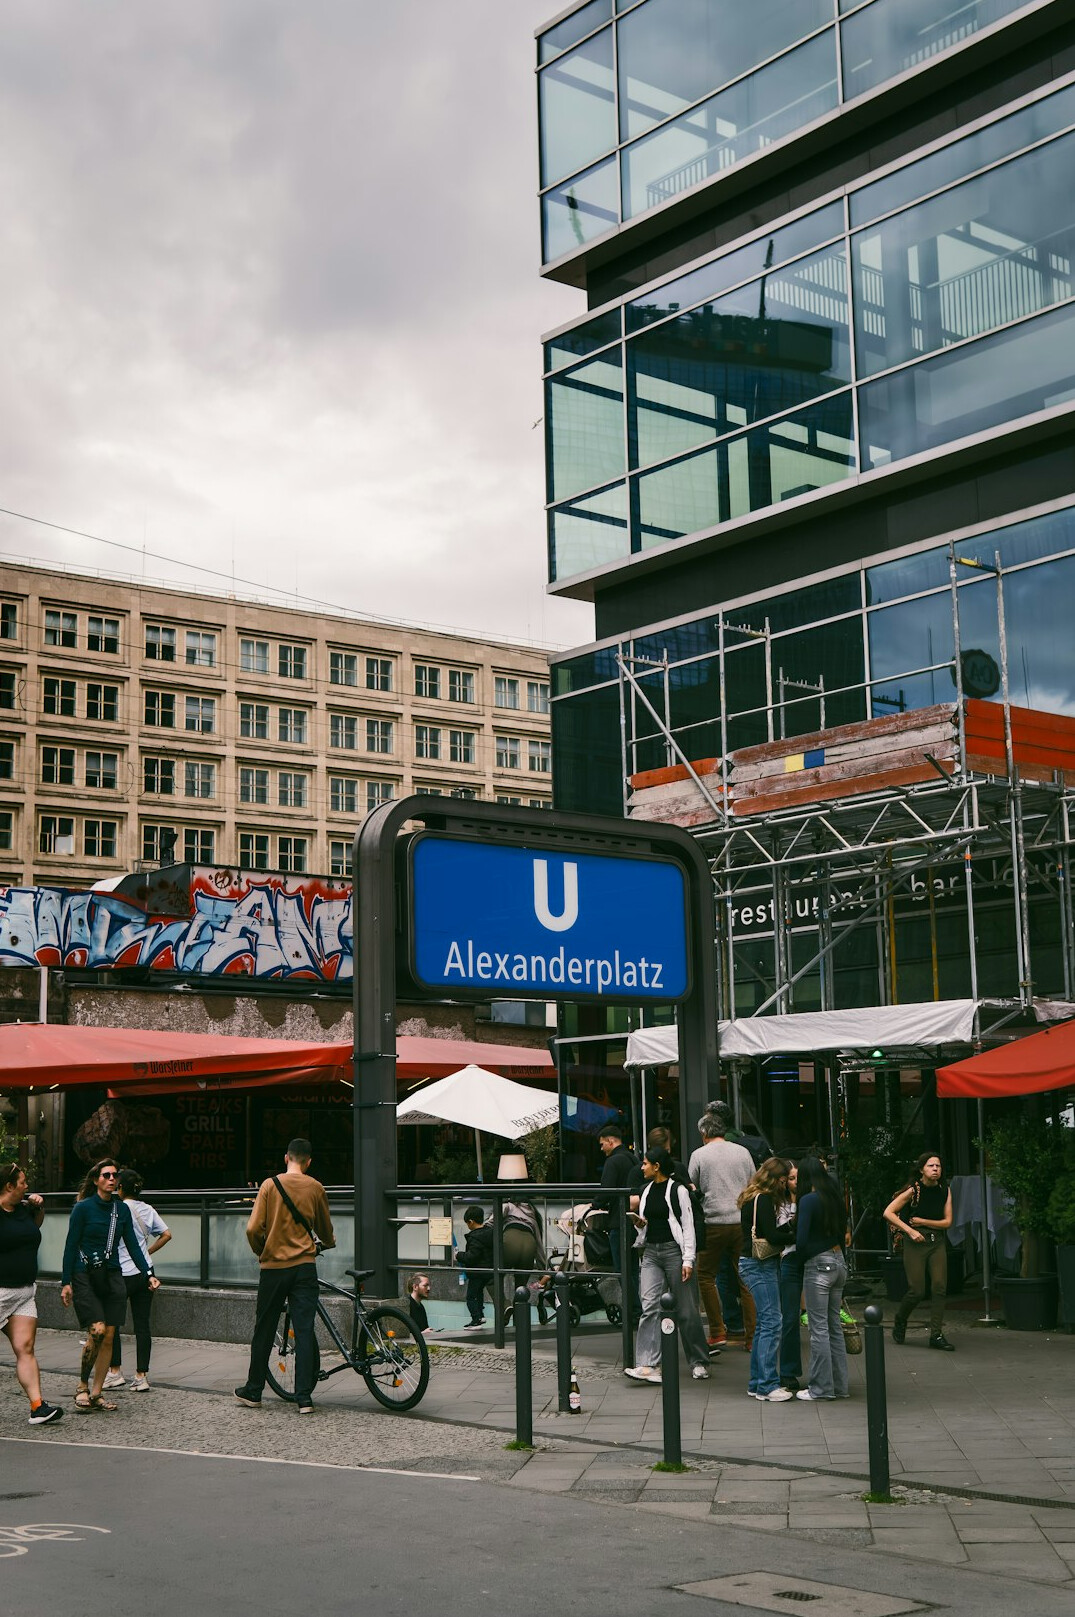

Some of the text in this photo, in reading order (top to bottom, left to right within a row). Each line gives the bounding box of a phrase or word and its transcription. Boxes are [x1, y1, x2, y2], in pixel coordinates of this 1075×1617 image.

[533, 858, 579, 932] U
[910, 873, 960, 901] bar
[443, 939, 665, 995] Alexanderplatz
[149, 1059, 194, 1075] Warsteiner
[175, 1095, 243, 1114] STEAKS
[184, 1114, 234, 1132] GRILL
[179, 1133, 236, 1151] SPARE
[189, 1151, 227, 1169] RIBS
